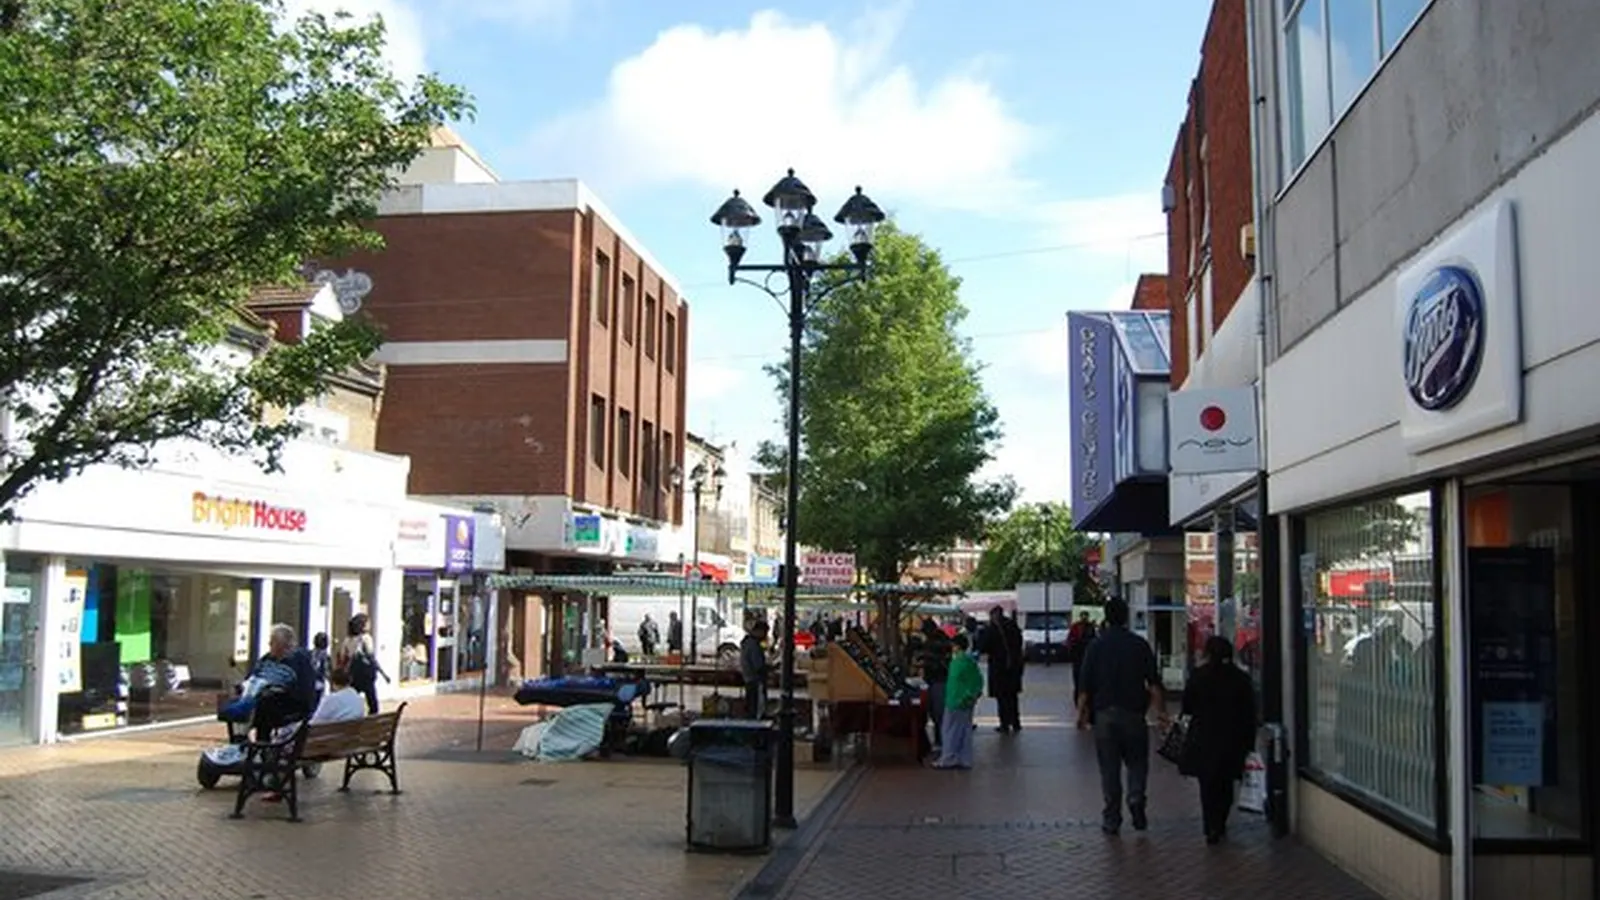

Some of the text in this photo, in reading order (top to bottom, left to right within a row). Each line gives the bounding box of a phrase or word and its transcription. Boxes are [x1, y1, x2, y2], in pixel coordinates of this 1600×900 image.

[1079, 326, 1099, 503] GRAYS CENTRE
[806, 555, 854, 566] WATCH
